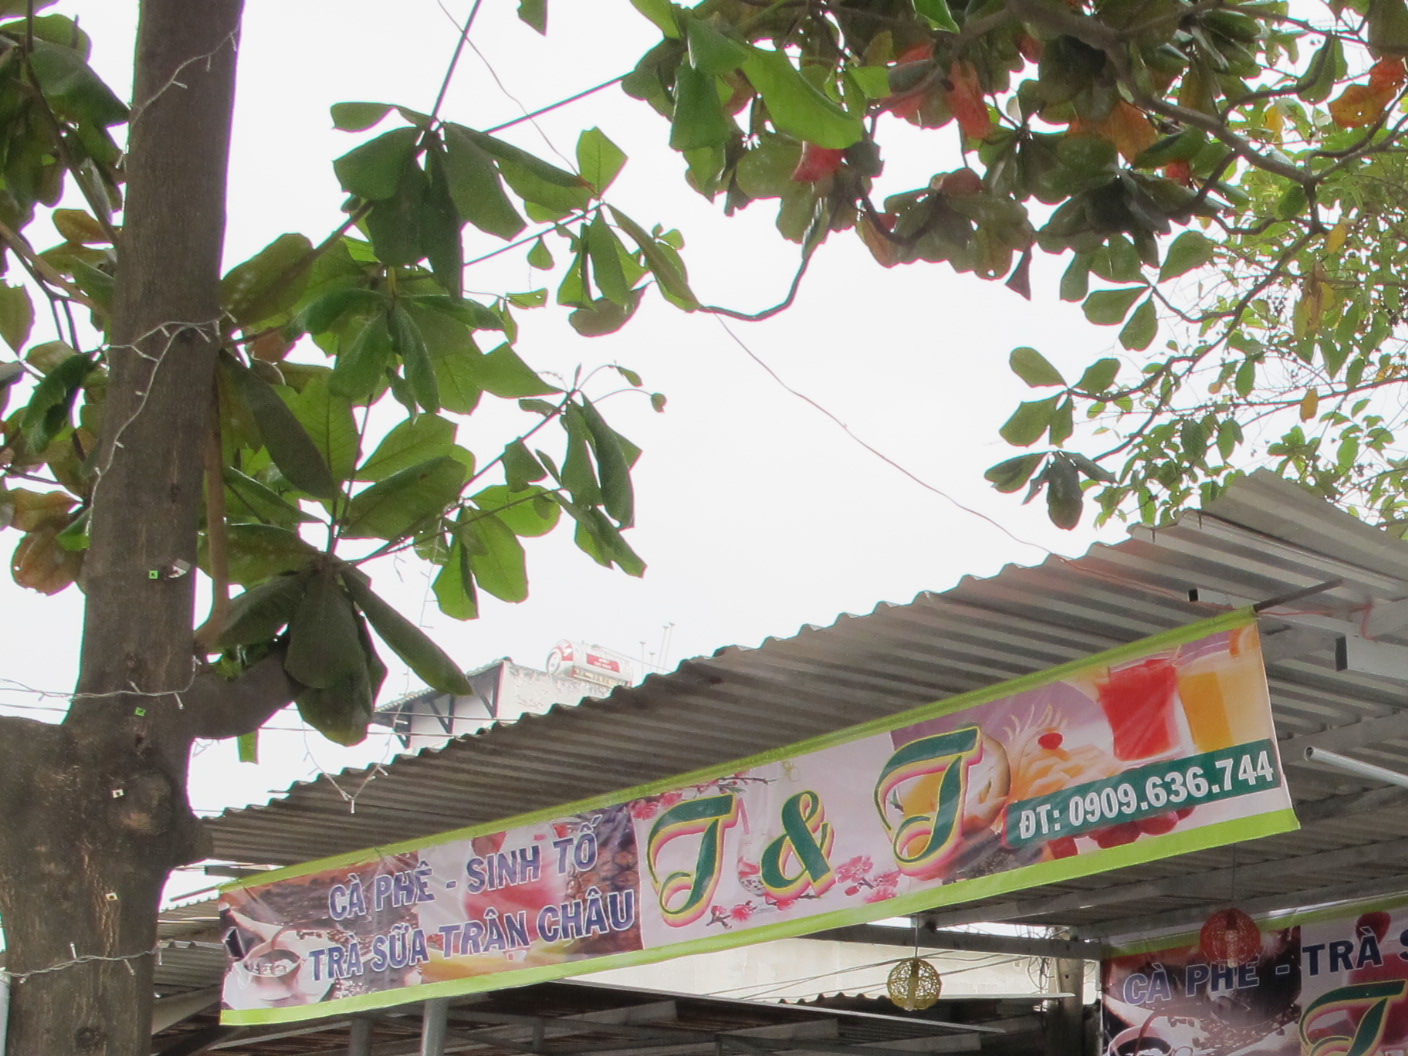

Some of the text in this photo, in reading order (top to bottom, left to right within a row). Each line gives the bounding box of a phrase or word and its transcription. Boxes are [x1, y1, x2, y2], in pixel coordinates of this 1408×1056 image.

[646, 725, 984, 927] T & T
[1018, 749, 1275, 841] ĐT: 0909.636.744
[328, 879, 368, 921] CÀ
[374, 861, 436, 912] PHÊ
[466, 843, 543, 893] SINH
[552, 815, 603, 871] TỐ
[308, 888, 636, 983] TRÀ SỮA TRÂN CHÂU
[1121, 962, 1172, 1006] CÀ
[1301, 925, 1384, 978] TRÀ
